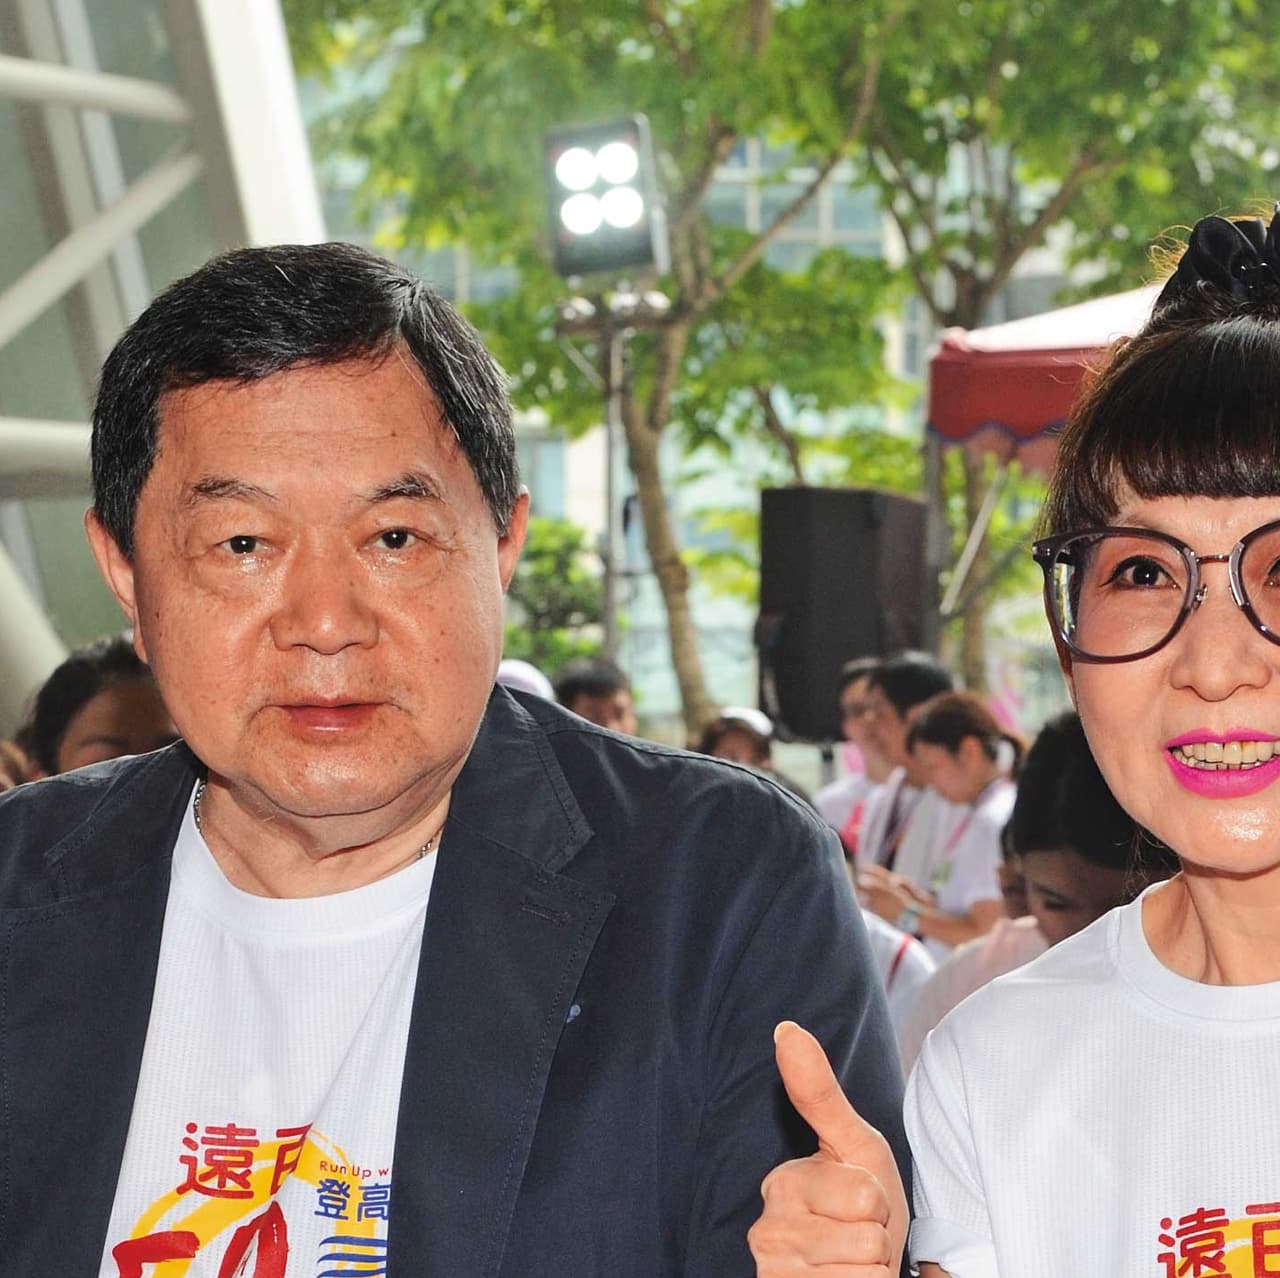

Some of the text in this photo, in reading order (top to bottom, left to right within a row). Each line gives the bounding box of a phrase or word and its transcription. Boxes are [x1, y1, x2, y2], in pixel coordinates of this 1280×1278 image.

[320, 1161, 347, 1175] Run
[352, 1164, 372, 1180] Up
[314, 1178, 391, 1222] 登高
